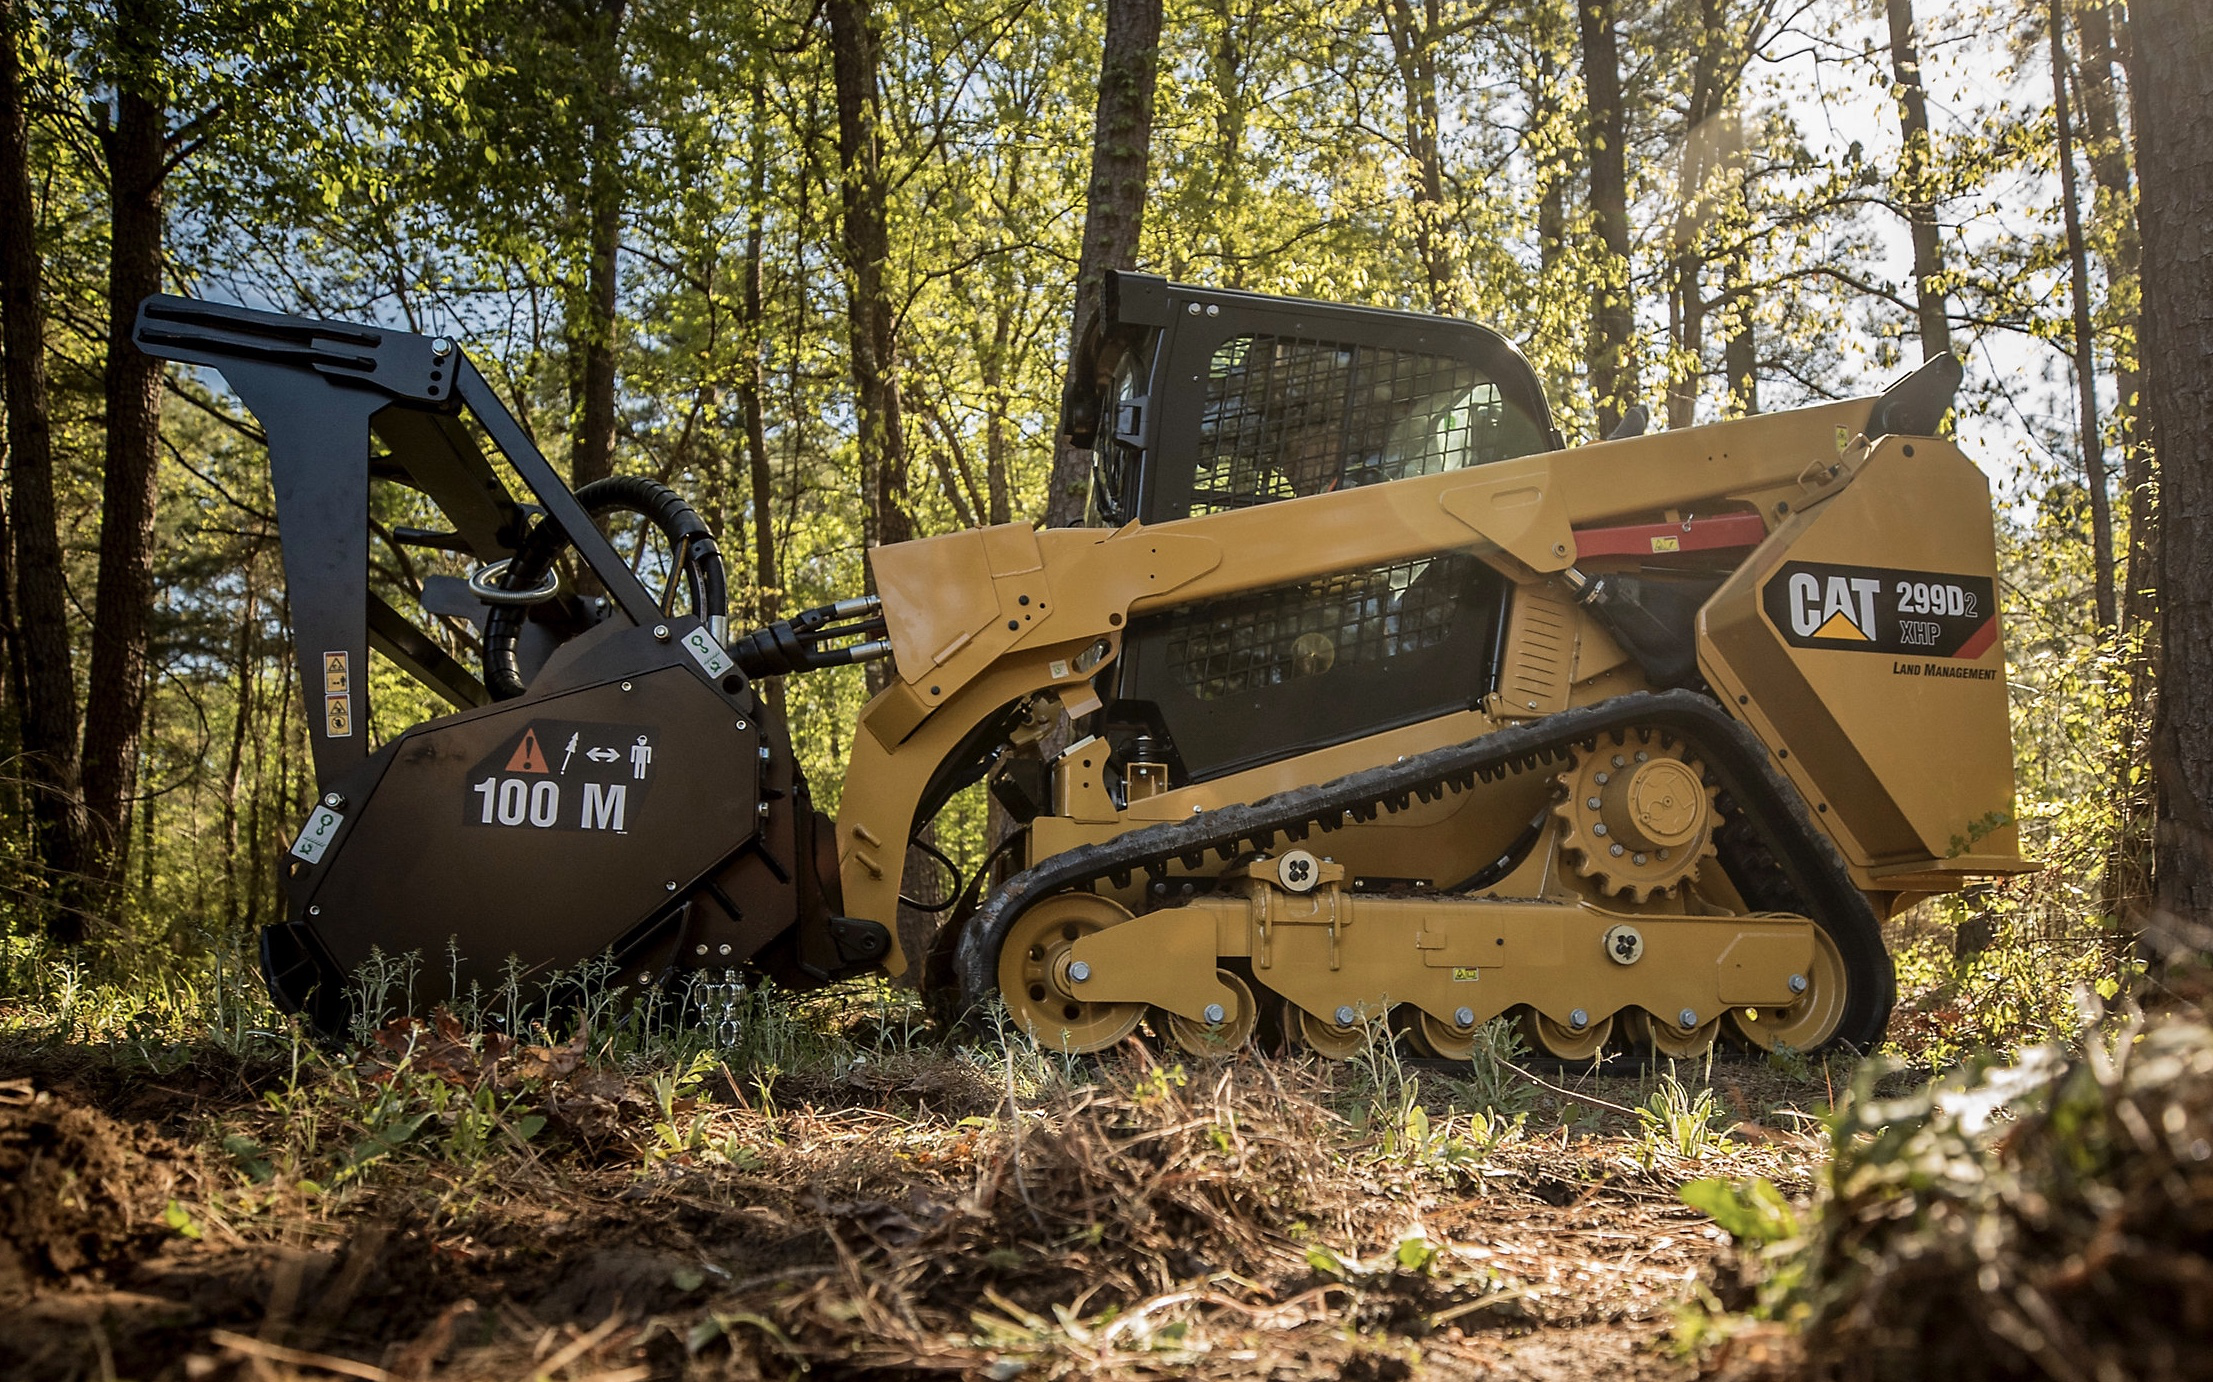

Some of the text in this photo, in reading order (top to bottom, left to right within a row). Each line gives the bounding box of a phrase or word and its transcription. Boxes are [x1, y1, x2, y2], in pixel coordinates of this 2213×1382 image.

[1788, 572, 1881, 642] CAT
[1896, 581, 1978, 618] 299D2
[1899, 620, 1941, 646] XHP
[474, 777, 627, 830] 100 M
